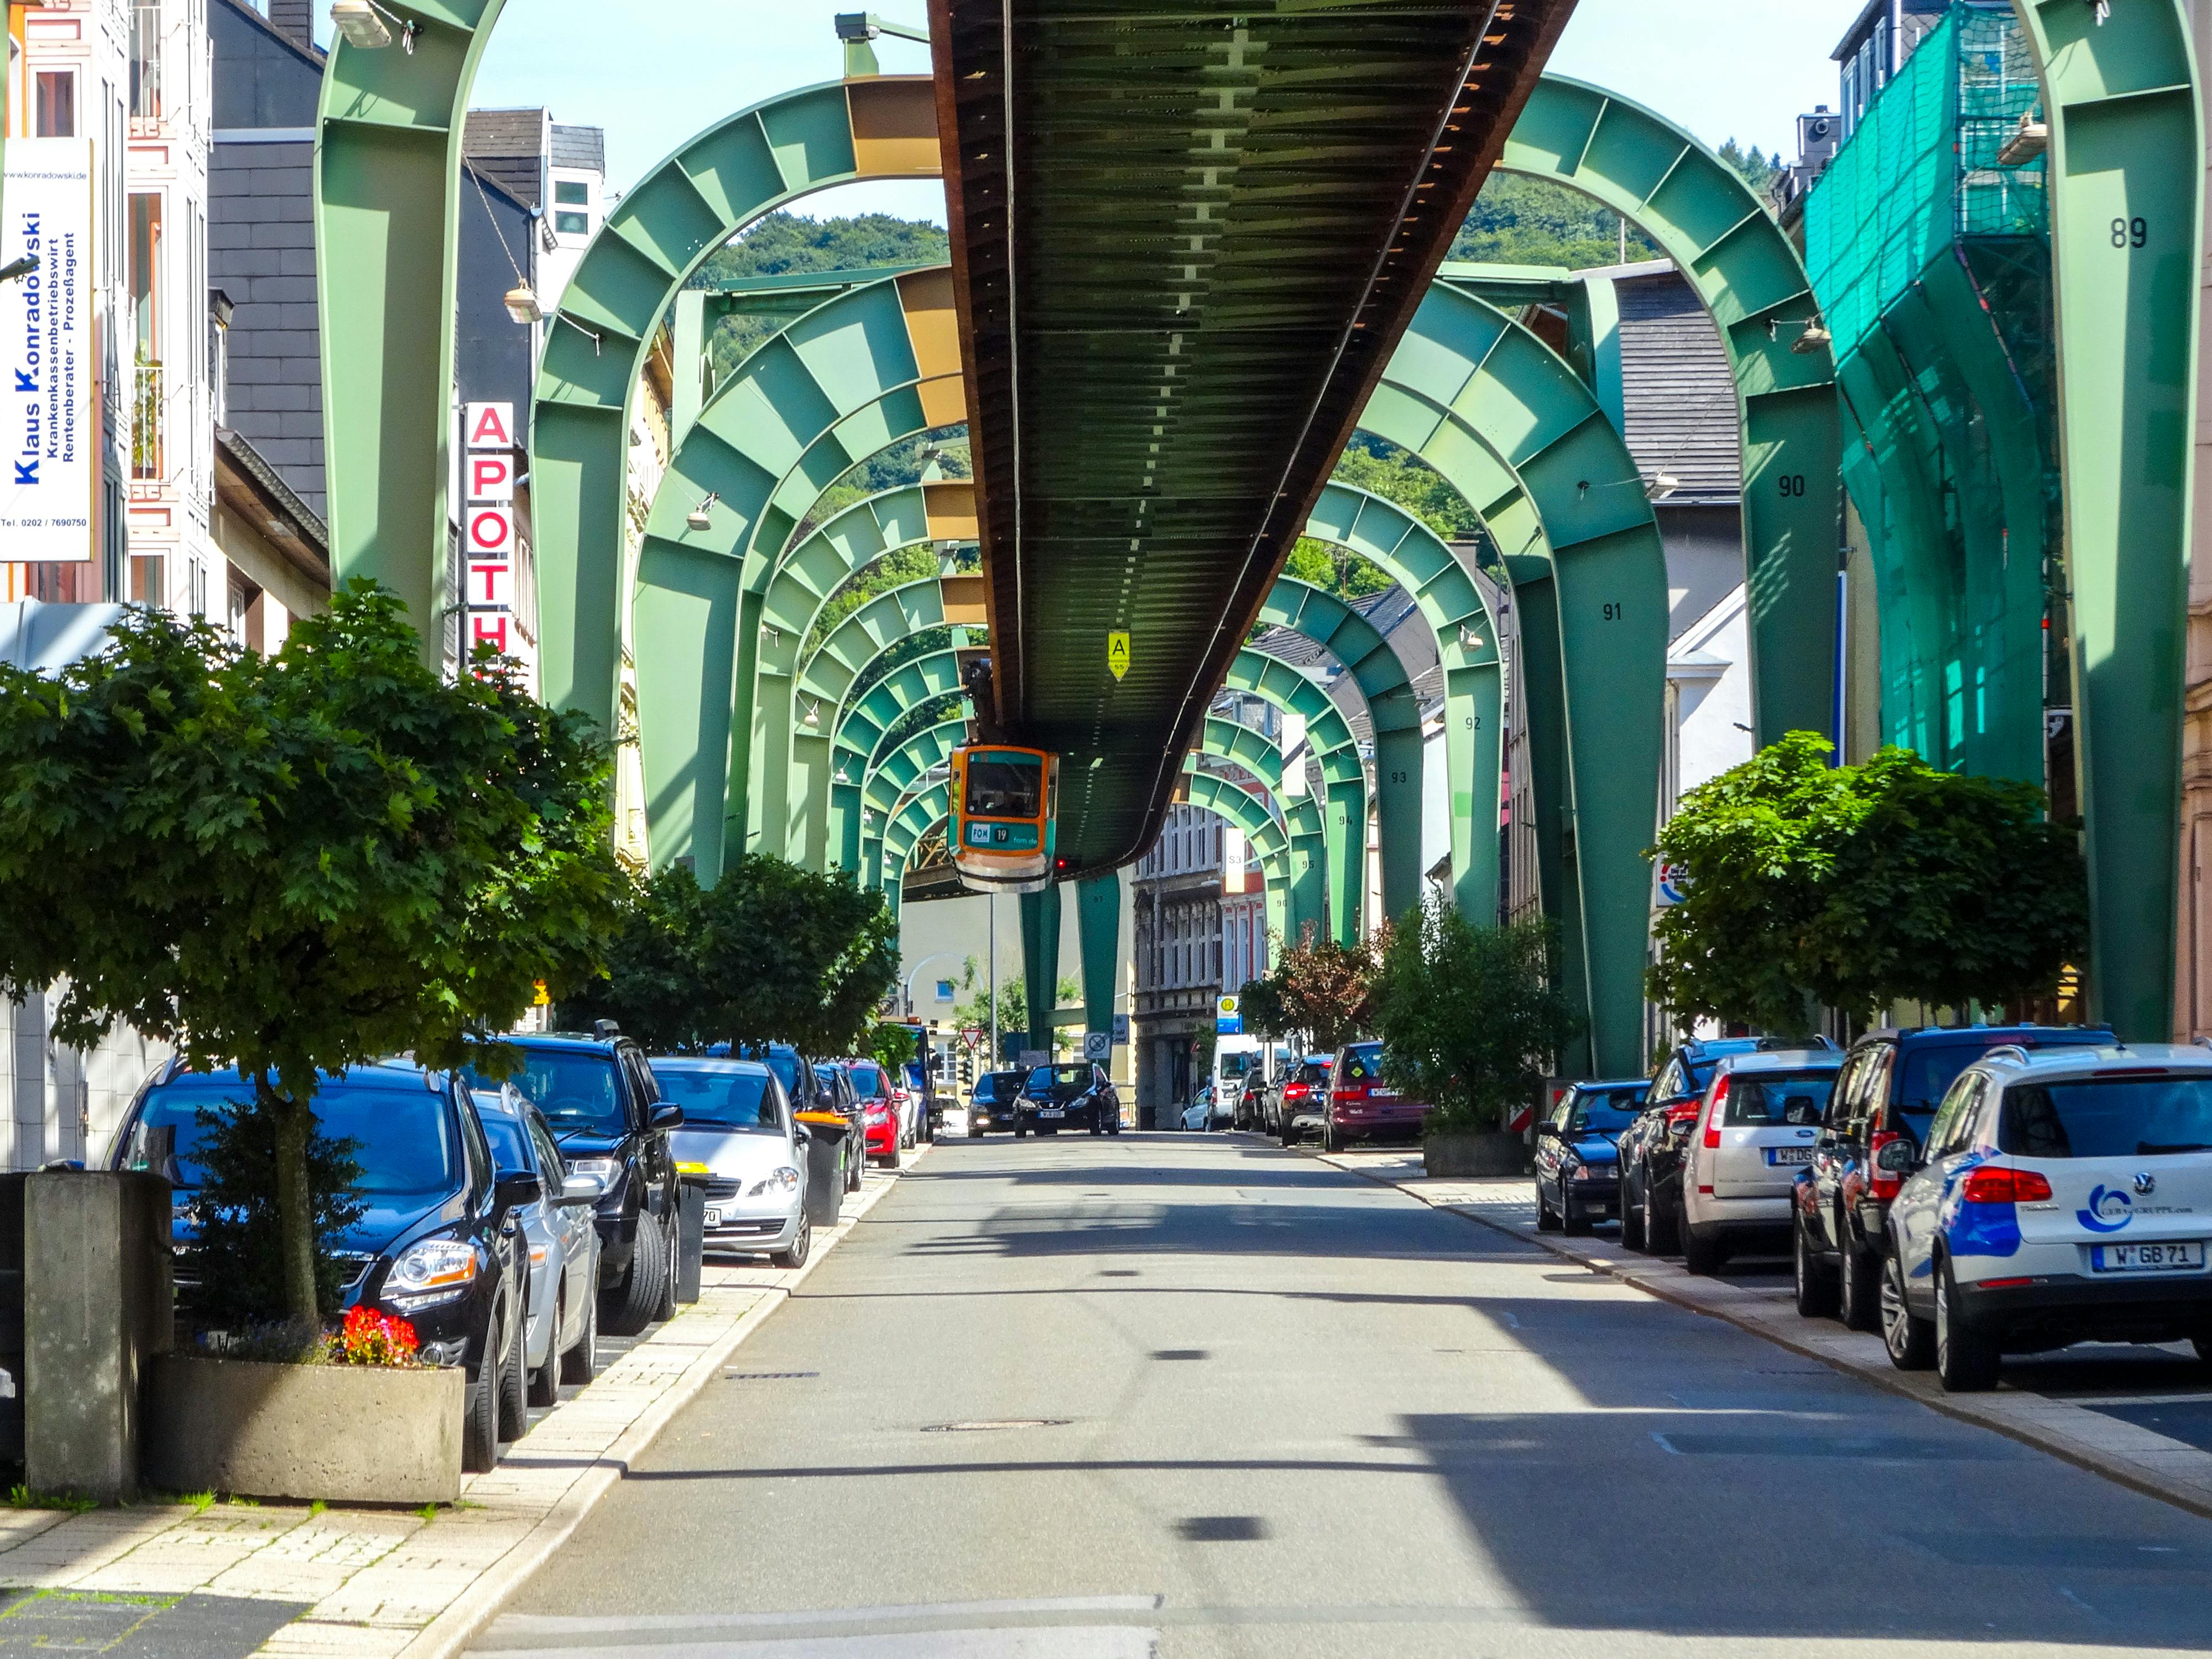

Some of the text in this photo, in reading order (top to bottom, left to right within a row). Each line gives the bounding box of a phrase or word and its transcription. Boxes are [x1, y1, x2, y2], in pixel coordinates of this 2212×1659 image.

[2111, 217, 2147, 249] 89
[63, 232, 77, 331] Prozeßagent
[48, 238, 58, 458] Krankenkassenbetriebswirt
[63, 349, 74, 462] Rentenberater
[14, 403, 40, 484] Klaus
[1779, 475, 1804, 497] 90
[1, 519, 18, 527] Tel.
[21, 519, 43, 527] 0202
[51, 519, 87, 527] 7690750
[471, 408, 509, 690] APOTH
[1603, 602, 1621, 620] 91
[1112, 638, 1125, 655] A
[1465, 716, 1481, 730] 92
[1391, 771, 1406, 784] 93
[1339, 816, 1352, 825] 94
[973, 829, 988, 838] FOM
[997, 830, 1006, 841] 19
[1229, 855, 1241, 864] S3
[1302, 860, 1314, 869] 95
[1276, 899, 1287, 907] 96
[1781, 1149, 1812, 1161] W DG
[2115, 1245, 2189, 1264] W GB 71
